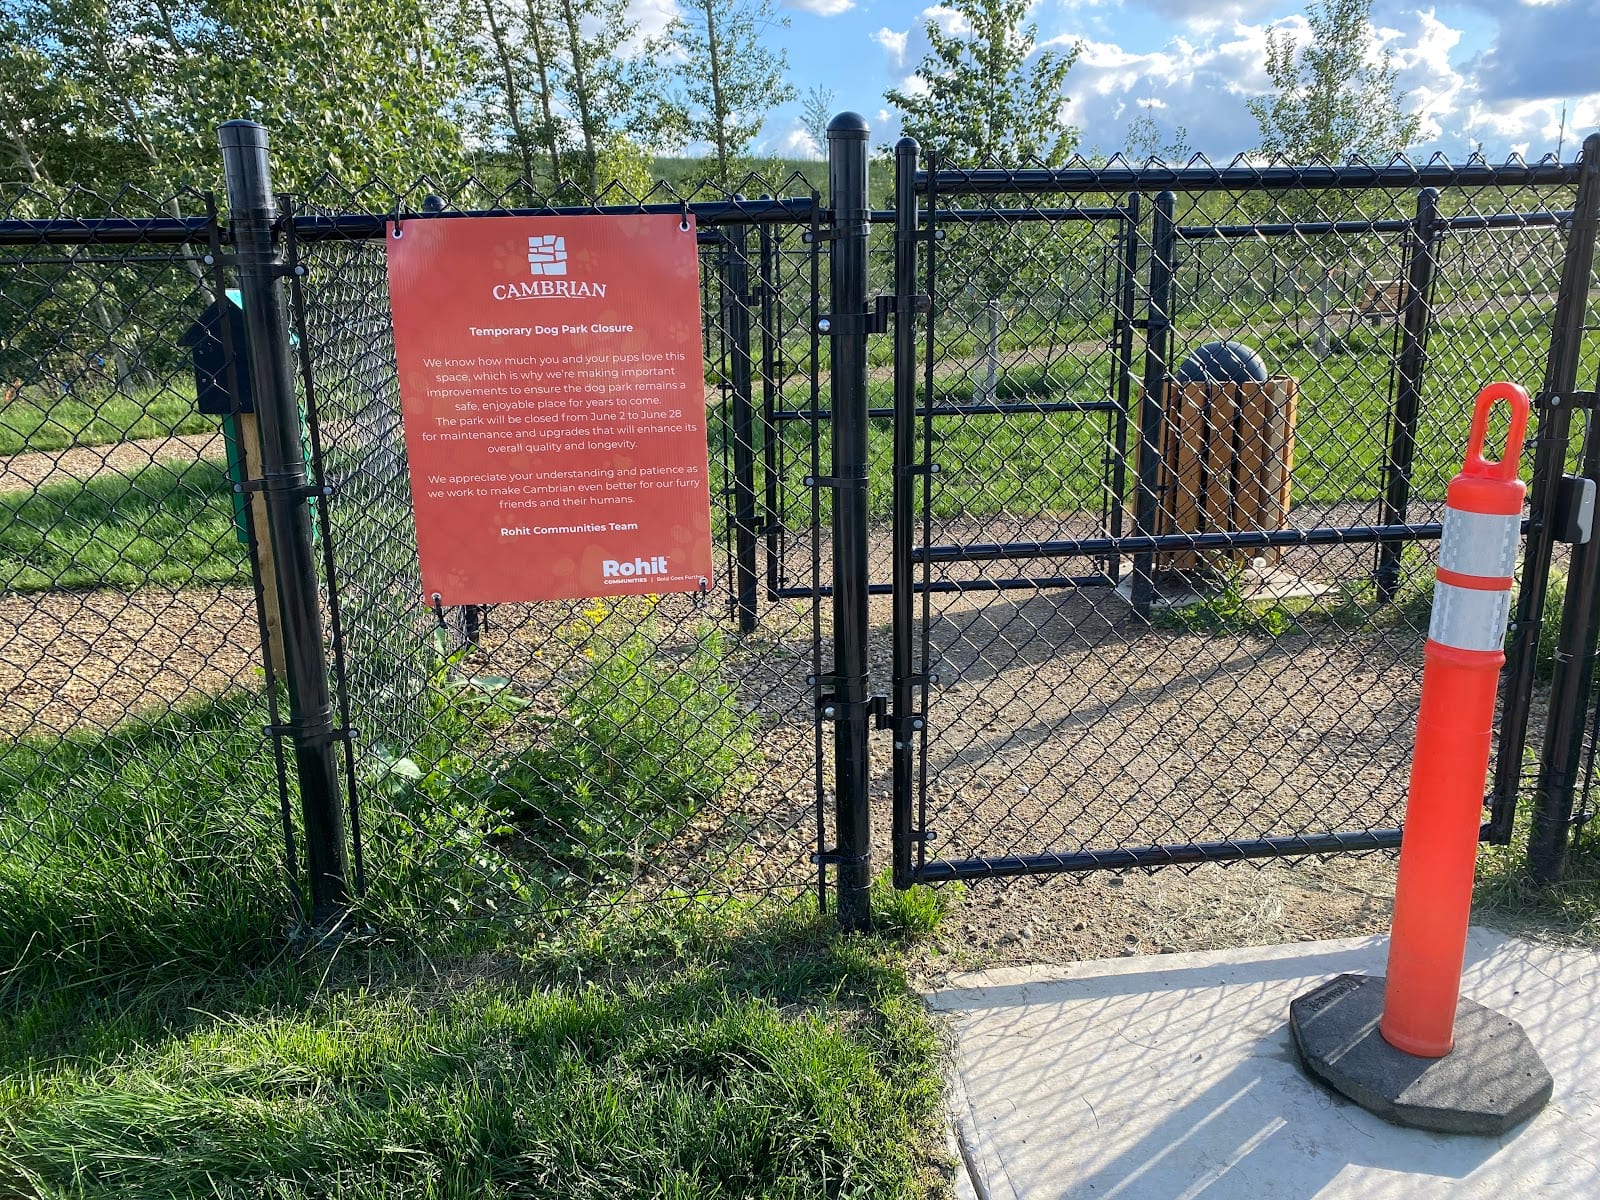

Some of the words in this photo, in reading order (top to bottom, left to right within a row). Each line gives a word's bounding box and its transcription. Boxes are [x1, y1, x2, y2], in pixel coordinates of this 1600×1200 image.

[492, 281, 607, 301] CAMBRIAN
[468, 327, 532, 338] Temporary
[534, 325, 558, 336] Dog
[561, 323, 588, 336] Park
[590, 323, 634, 333] Closure
[422, 358, 442, 368] We
[444, 357, 475, 367] know
[478, 356, 502, 366] how
[504, 355, 536, 365] much
[539, 356, 559, 366] you
[562, 354, 582, 363] and
[585, 355, 610, 365] your
[612, 354, 639, 364] pups
[642, 352, 663, 361] love
[665, 351, 685, 360] this
[436, 374, 470, 384] space,
[472, 370, 506, 381] which
[509, 370, 518, 380] is
[520, 370, 543, 382] why
[545, 369, 575, 379] we're
[577, 368, 618, 379] making
[622, 367, 675, 378] important
[426, 387, 508, 398] improvements
[510, 387, 521, 395] to
[524, 386, 561, 394] ensure
[563, 384, 582, 393] the
[584, 383, 605, 394] dog
[608, 382, 632, 393] park
[635, 381, 678, 390] remains
[454, 401, 480, 411] safe,
[482, 400, 535, 412] enjoyable
[537, 399, 566, 410] place
[568, 398, 583, 407] for
[585, 399, 614, 409] years
[629, 397, 661, 409] come.
[434, 416, 456, 426] The
[459, 416, 484, 427] park
[486, 415, 504, 424] will
[508, 414, 522, 424] be
[524, 413, 558, 423] closed
[561, 412, 588, 422] from
[590, 412, 616, 421] June
[619, 411, 625, 420] 2
[627, 410, 638, 420] to
[640, 410, 667, 419] June
[669, 409, 682, 418] 28
[421, 432, 437, 441] for
[440, 430, 512, 440] maintenance
[515, 428, 536, 438] and
[539, 427, 590, 438] upgrades
[592, 425, 614, 435] that
[616, 425, 634, 434] will
[636, 424, 682, 434] enhance
[685, 423, 697, 432] its
[487, 443, 522, 453] overall
[525, 442, 562, 454] quality
[564, 441, 584, 450] and
[588, 439, 638, 451] longevity.
[428, 475, 446, 484] We
[448, 472, 506, 485] appreciate
[508, 473, 533, 483] your
[536, 468, 614, 479] understanding
[616, 466, 636, 476] and
[639, 465, 684, 477] patience
[446, 487, 474, 497] work
[476, 488, 488, 496] to
[490, 486, 520, 495] make
[522, 483, 575, 494] Cambrian
[606, 482, 637, 490] better
[639, 480, 653, 489] for
[676, 478, 700, 488] furry
[499, 499, 538, 509] friends
[539, 497, 560, 507] and
[562, 496, 587, 506] their
[590, 496, 635, 504] humans.
[500, 526, 531, 537] Rohit
[533, 522, 606, 534] Communities
[608, 522, 638, 531] Team
[602, 556, 668, 577] Rohit
